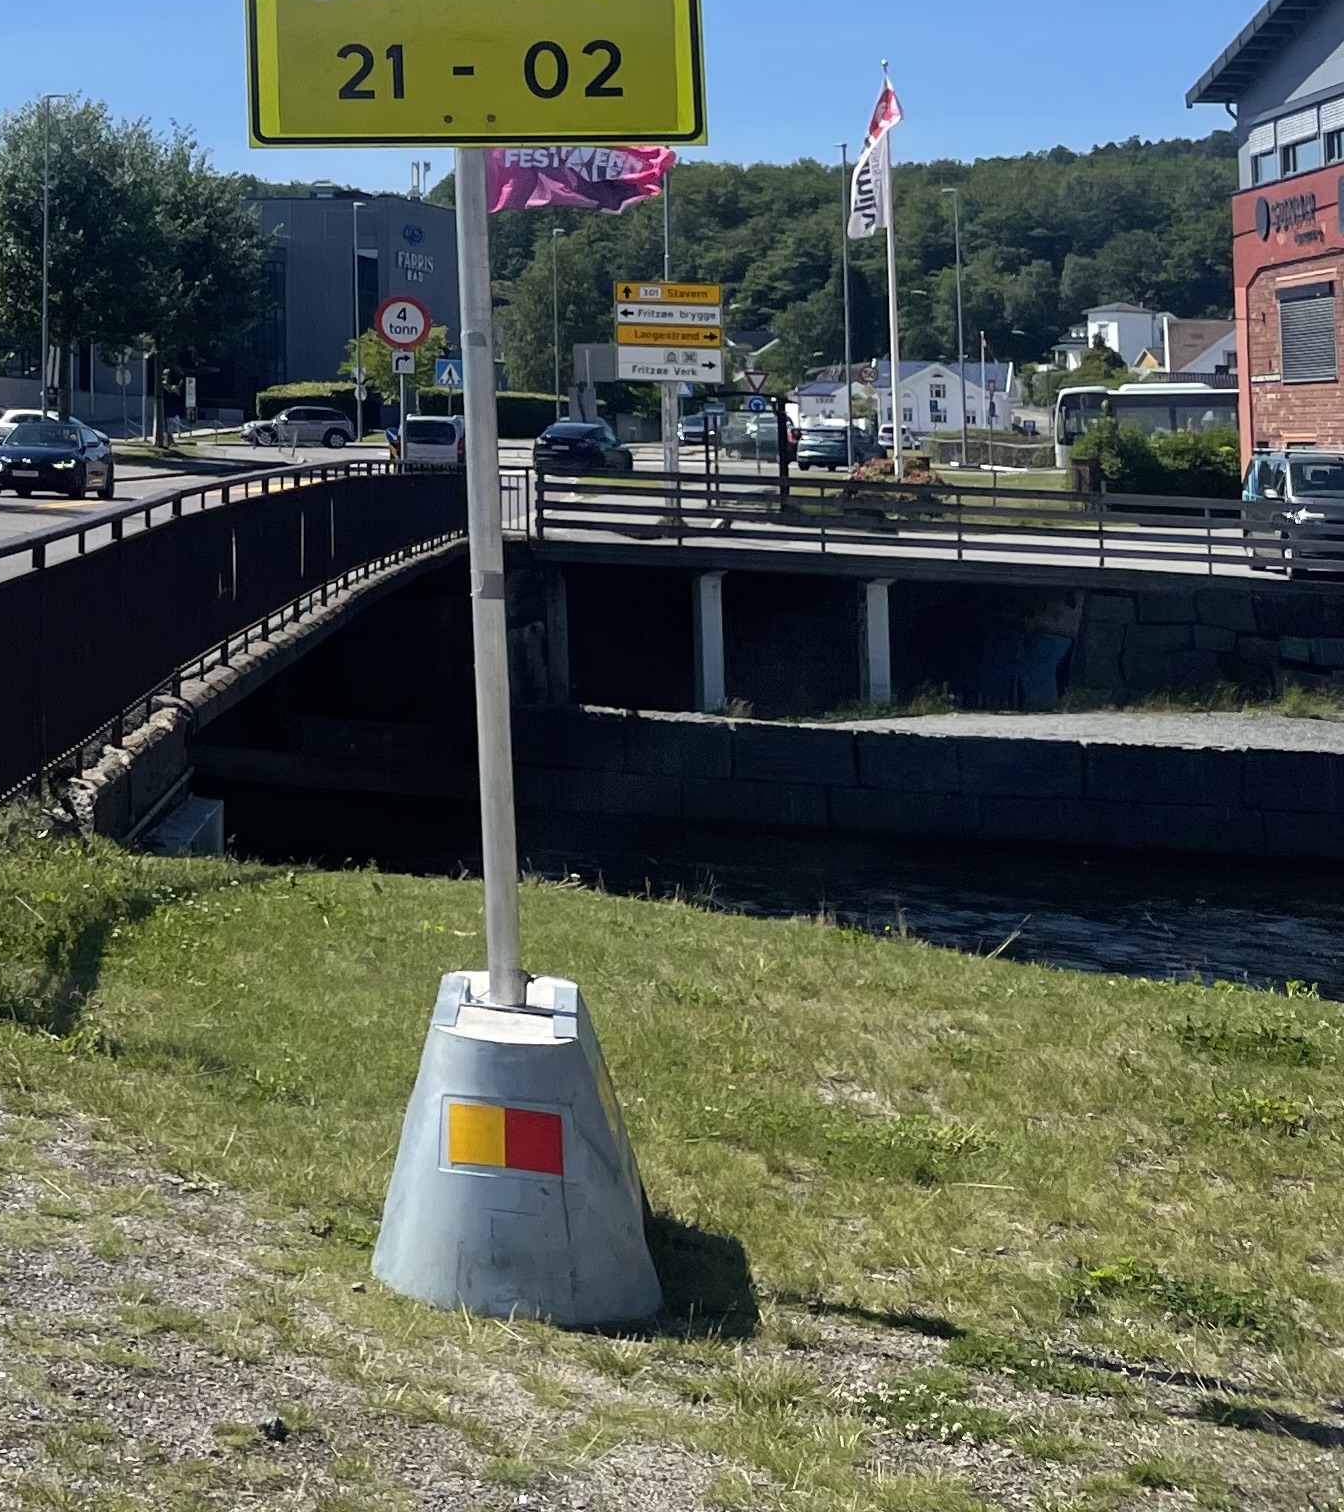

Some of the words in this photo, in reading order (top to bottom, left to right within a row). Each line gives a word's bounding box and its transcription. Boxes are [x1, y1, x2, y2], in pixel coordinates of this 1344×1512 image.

[336, 43, 405, 100] 21
[523, 40, 624, 99] 02
[667, 289, 708, 298] Stavern
[396, 308, 407, 322] 4
[638, 309, 674, 318] Fritzøe
[679, 310, 716, 321] brygge
[389, 324, 418, 335] tonn
[634, 330, 700, 342] Langestrand
[632, 365, 668, 375] Fritzøe
[673, 367, 697, 376] Verk
